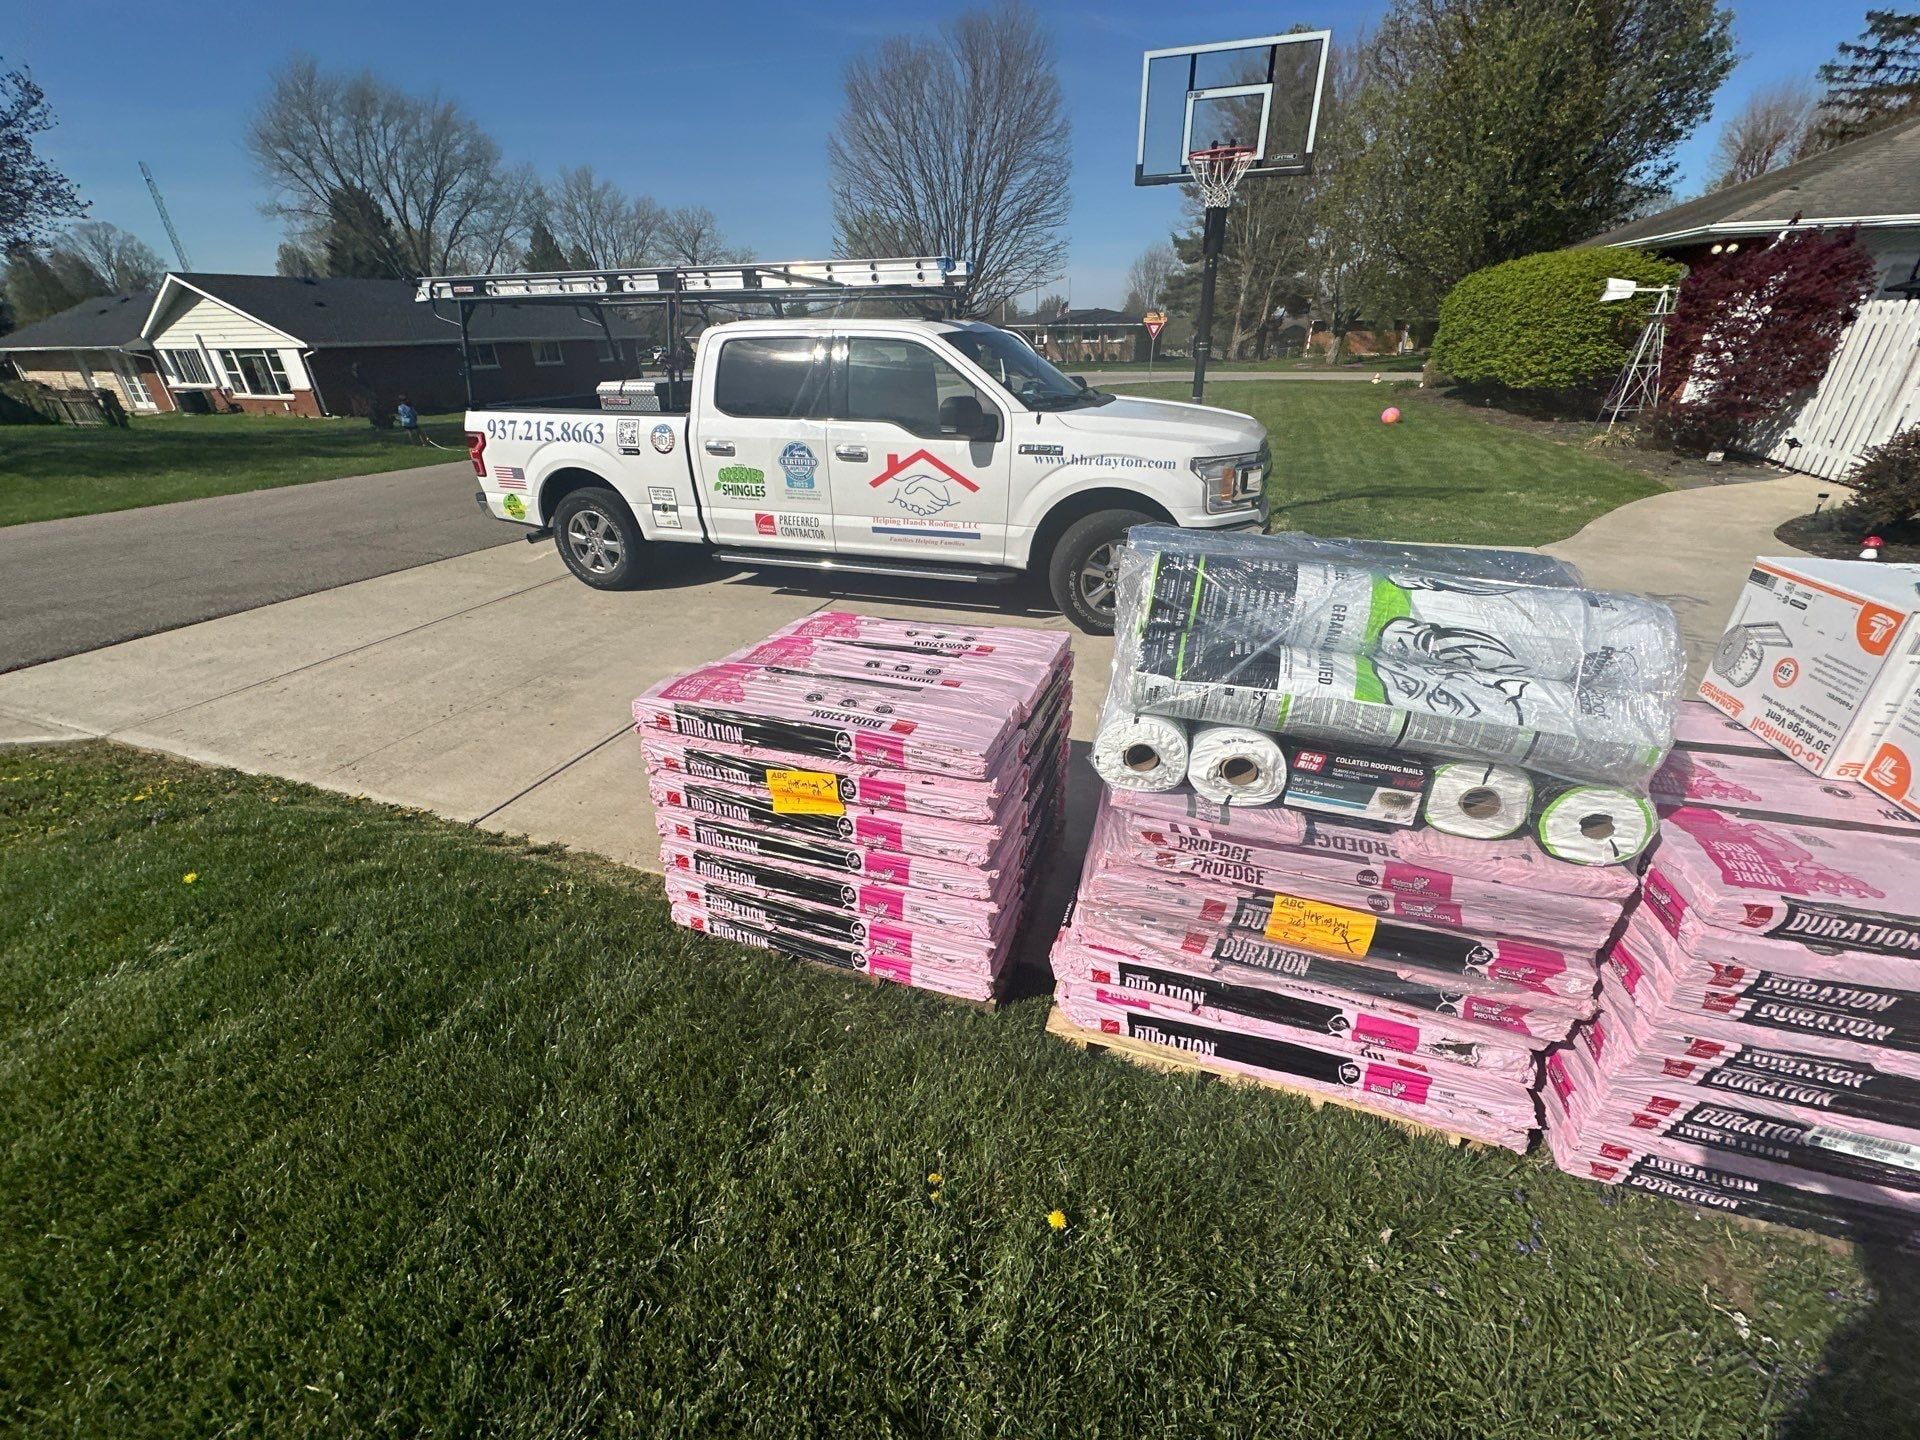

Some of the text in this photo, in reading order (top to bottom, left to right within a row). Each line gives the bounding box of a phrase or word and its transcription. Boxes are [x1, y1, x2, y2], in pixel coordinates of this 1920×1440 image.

[487, 419, 605, 444] 937.215.8663
[1034, 454, 1176, 470] www.hhrdayton.com
[718, 467, 765, 484] GREENER
[722, 484, 766, 497] SHINGLES
[779, 515, 819, 527] PREFERRED
[780, 527, 826, 539] CONTRACTOR
[872, 516, 981, 529] Helping Hands Roofing, LLC
[1778, 665, 1793, 677] 330
[1700, 684, 1741, 718] LOMANCO
[1826, 693, 1854, 710] Features:
[681, 718, 743, 743] DURATION
[811, 709, 886, 729] DURATION
[1765, 708, 1831, 754] 30' Ridge Vent
[1749, 716, 1824, 771] Lo-OmniRoll
[1297, 761, 1319, 771] Rite
[1300, 752, 1323, 763] Grip
[1335, 757, 1424, 776] COLLATED ROOFING NAILS
[691, 797, 750, 821] DURATION
[699, 829, 759, 854] DURATION
[1178, 836, 1257, 863] PROEDGE
[1716, 850, 1764, 863] JUST A
[1722, 858, 1776, 875] THAN
[700, 861, 757, 886] DURATION
[1732, 870, 1786, 887] MORE
[1280, 898, 1305, 909] ABC
[713, 921, 769, 950] DURATION
[1786, 912, 1920, 950] DURATION
[1220, 938, 1311, 977] DURATION
[1125, 976, 1205, 1005] DURATION
[1757, 978, 1899, 1012] DURATION
[1474, 1011, 1514, 1022] PROTECTION
[1755, 1003, 1896, 1041] DURATION
[1134, 1027, 1213, 1056] DURATION
[1736, 1053, 1874, 1088] DURATION
[1710, 1070, 1840, 1107] DURATION
[1692, 1108, 1801, 1144] DURATIO
[1631, 1175, 1740, 1209] DURATION
